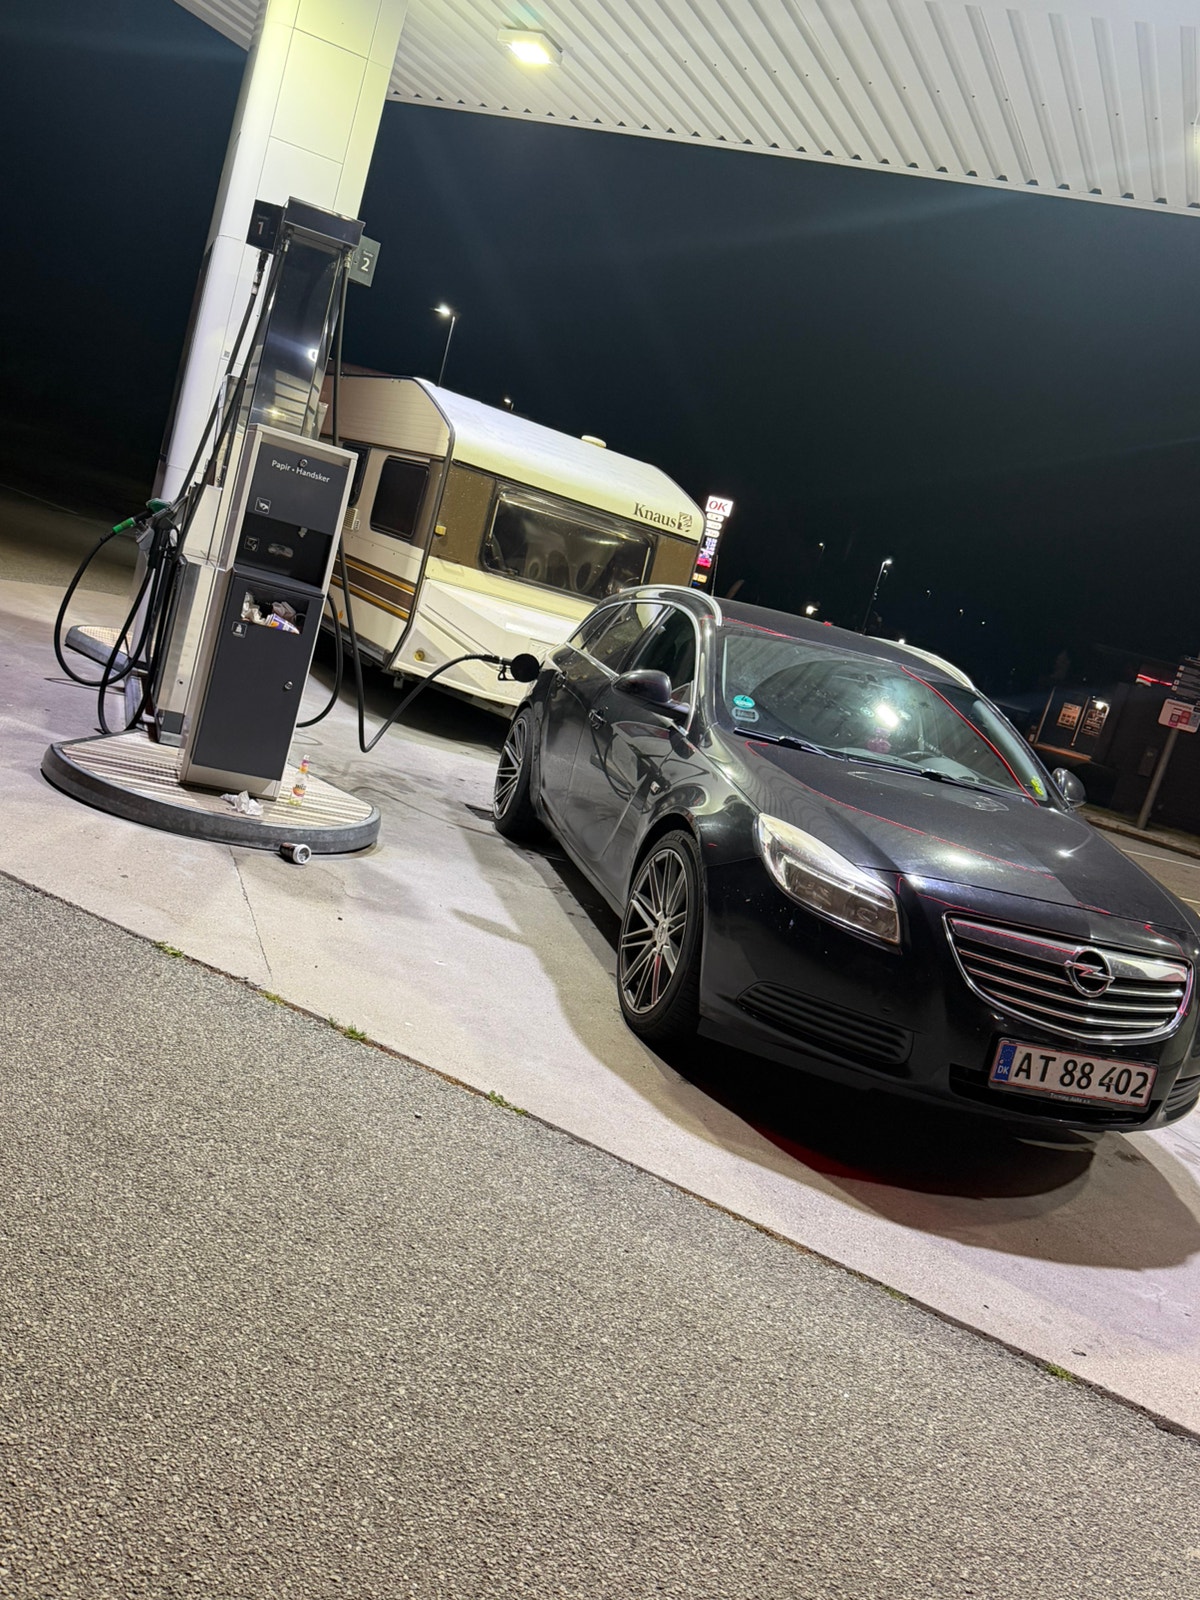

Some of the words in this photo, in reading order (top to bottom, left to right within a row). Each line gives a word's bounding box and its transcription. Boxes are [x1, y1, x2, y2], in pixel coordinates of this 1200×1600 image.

[258, 221, 264, 235] 1
[361, 257, 370, 272] 2
[271, 459, 291, 471] Papir
[296, 467, 331, 483] Handsker
[709, 500, 728, 513] OK
[633, 502, 678, 529] Knaus
[997, 1065, 1010, 1075] DK
[1014, 1052, 1057, 1083] AT
[1059, 1059, 1095, 1090] 88
[1098, 1066, 1149, 1099] 402
